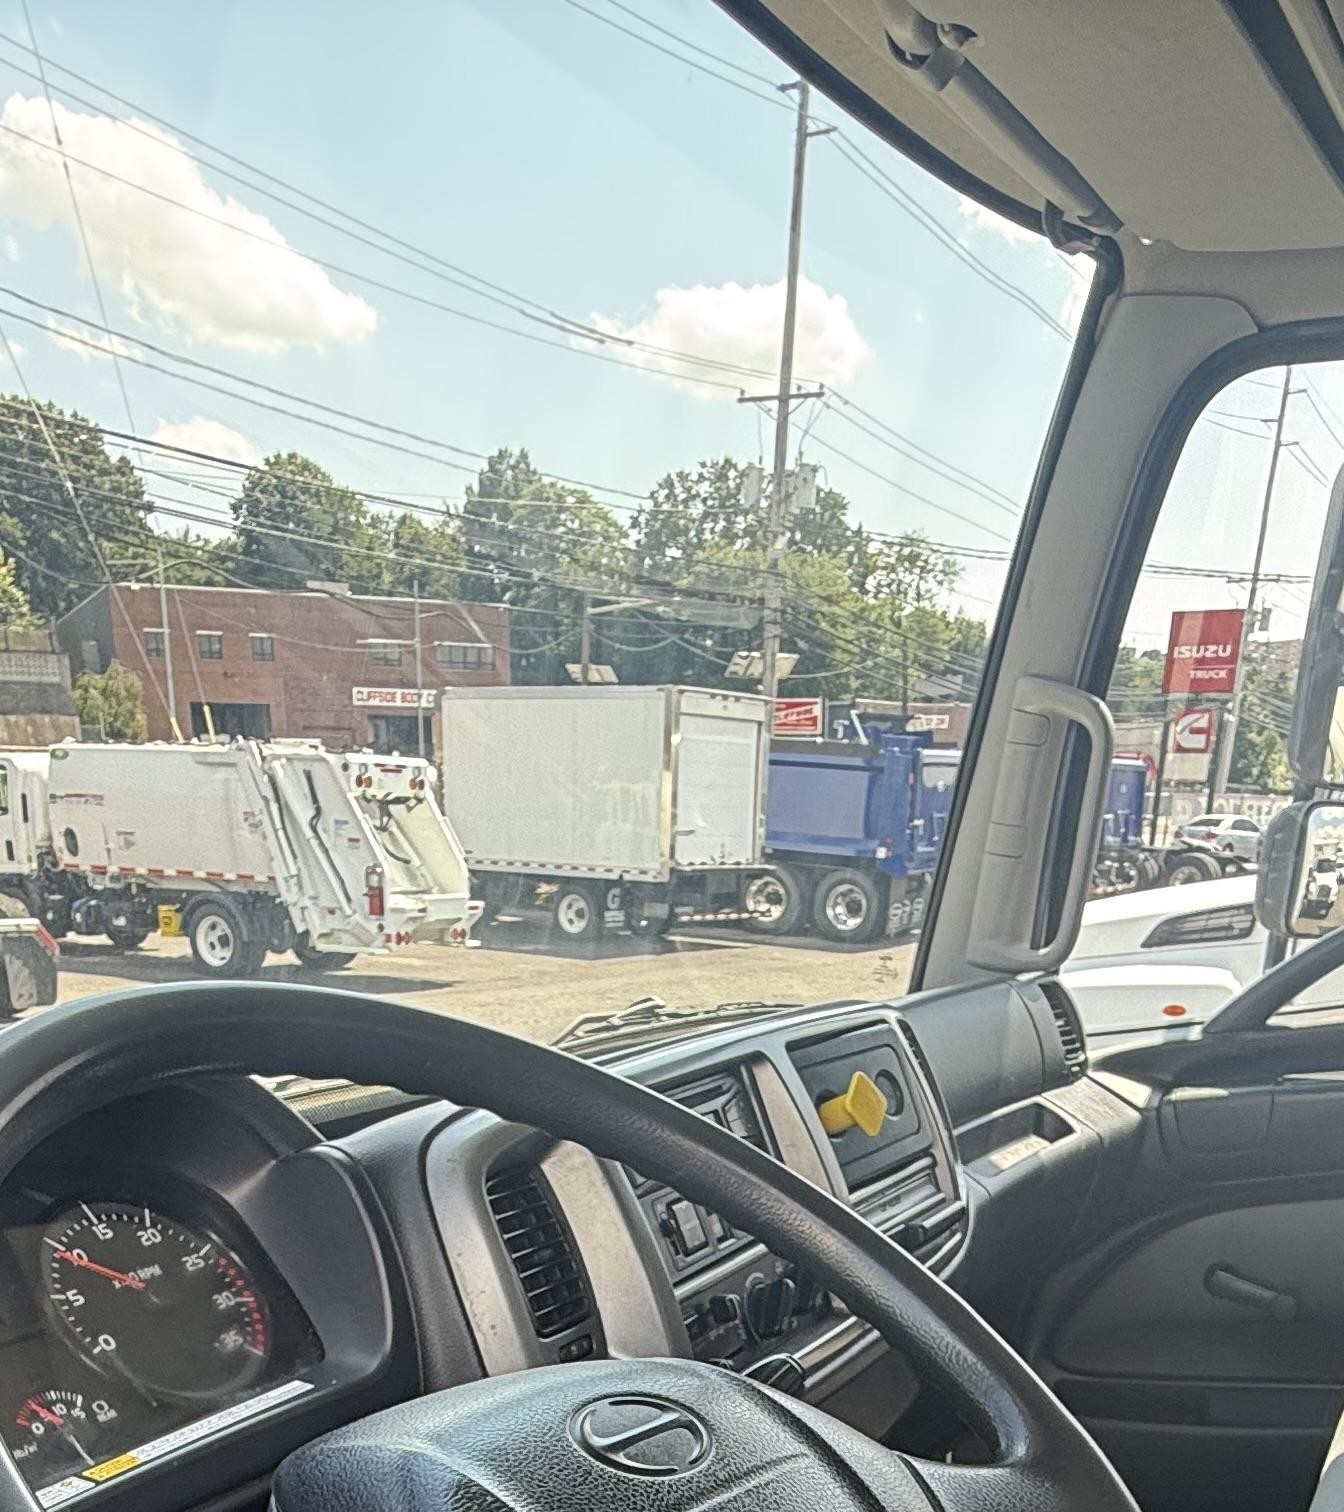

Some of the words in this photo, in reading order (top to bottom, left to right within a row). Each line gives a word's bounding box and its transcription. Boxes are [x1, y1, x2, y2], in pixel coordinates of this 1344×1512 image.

[1173, 644, 1231, 658] ISUZU
[1189, 669, 1228, 679] TRUCK
[92, 1223, 113, 1240] 15
[137, 1227, 161, 1247] 20
[181, 1254, 205, 1272] 25
[67, 1289, 85, 1307] 5
[212, 1291, 235, 1308] 30
[98, 1333, 116, 1352] 0
[220, 1328, 244, 1347] 35
[31, 1422, 45, 1435] 0
